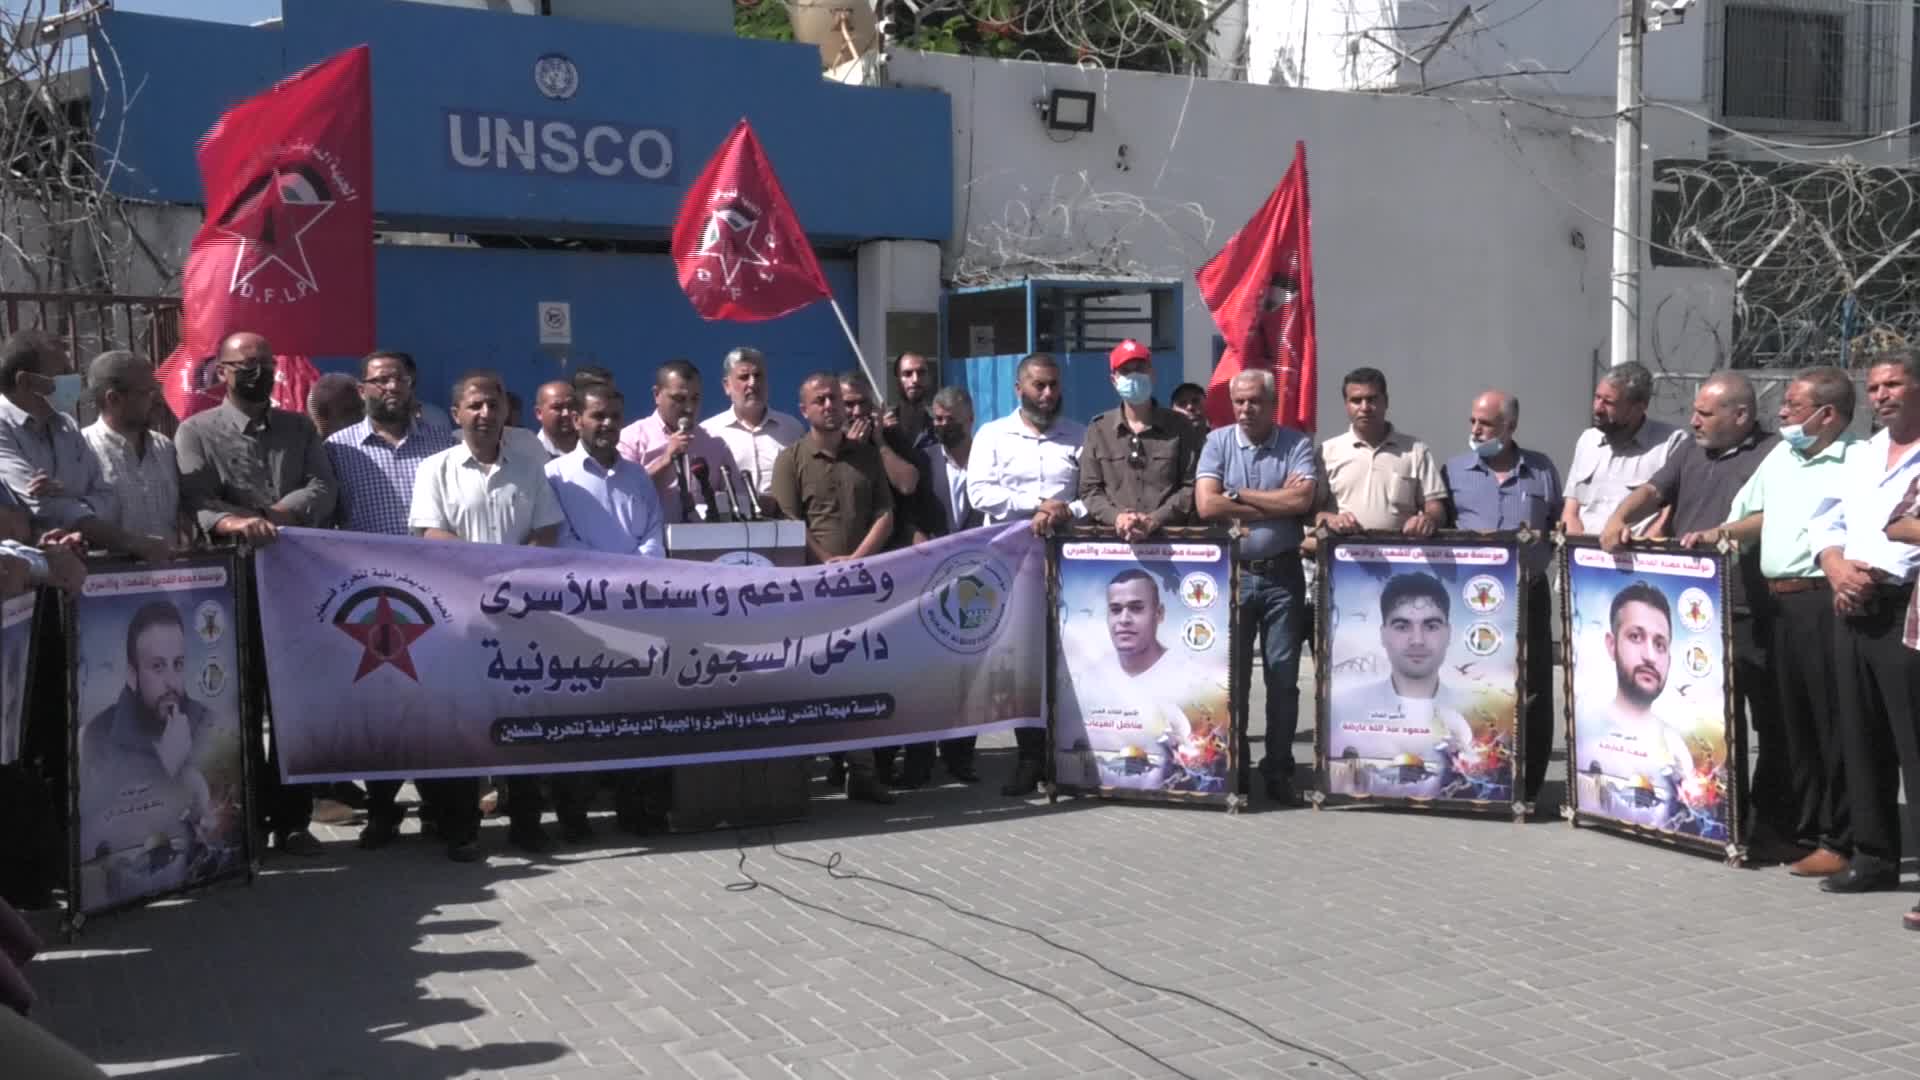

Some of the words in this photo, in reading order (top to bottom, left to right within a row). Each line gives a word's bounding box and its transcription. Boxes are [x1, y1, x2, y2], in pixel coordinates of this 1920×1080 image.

[448, 114, 673, 179] UNSCO
[480, 571, 610, 620] للأسرى
[738, 578, 804, 617] دعم
[814, 561, 895, 603] وقفة
[481, 637, 670, 695] الصهيونية
[677, 636, 803, 687] السجون
[809, 628, 888, 676] داخل
[587, 717, 658, 737] الديمقراطية
[788, 705, 823, 724] القدس
[853, 699, 887, 717] مؤسسة
[501, 721, 543, 743] فلسطين
[546, 721, 584, 741] لتحرير
